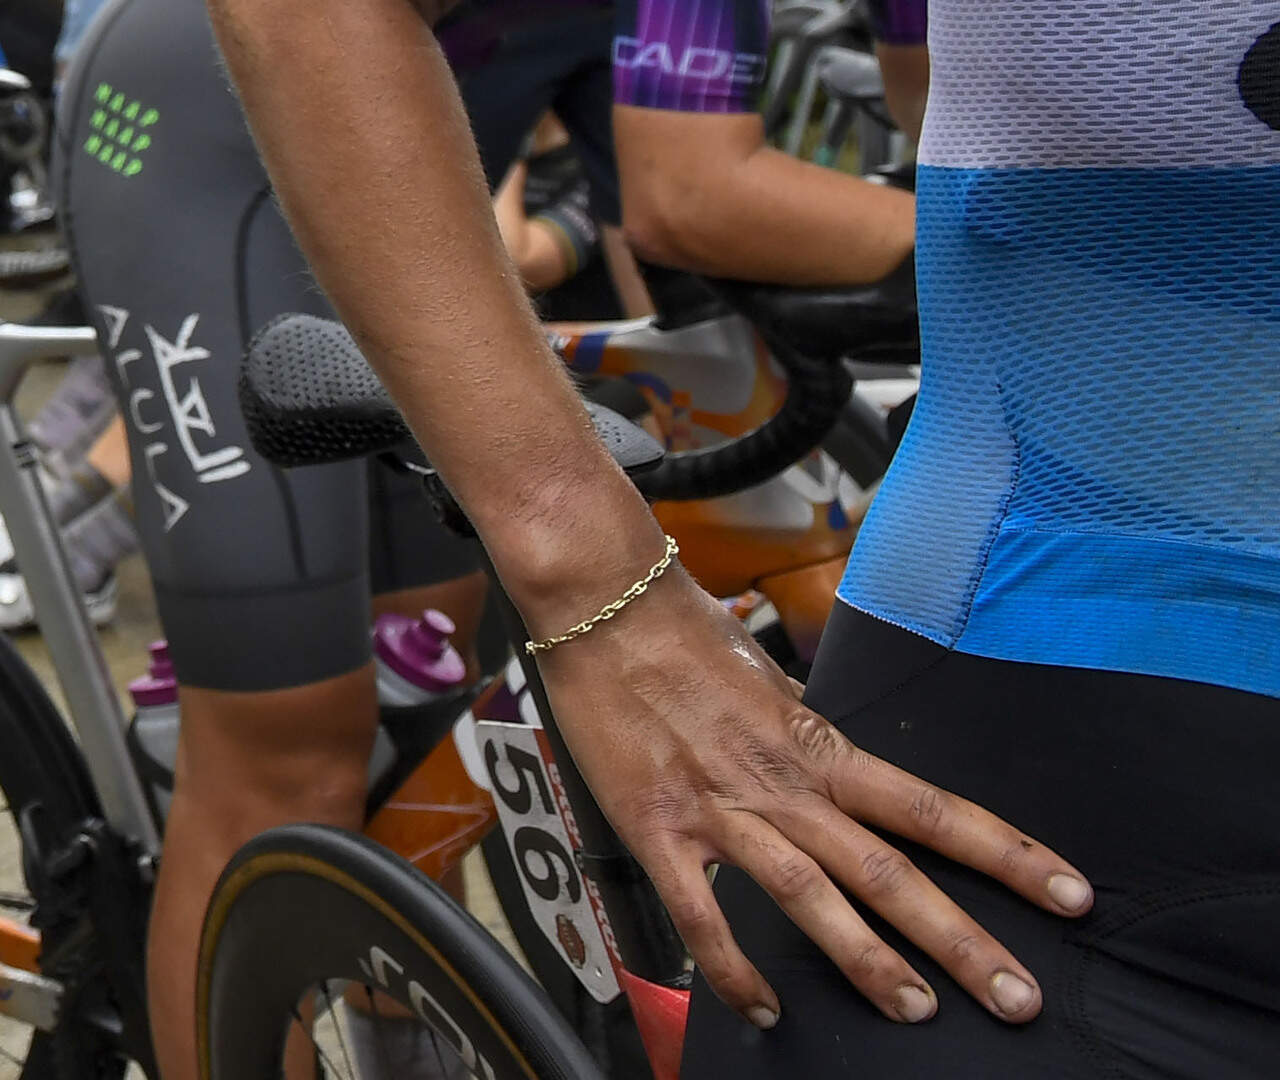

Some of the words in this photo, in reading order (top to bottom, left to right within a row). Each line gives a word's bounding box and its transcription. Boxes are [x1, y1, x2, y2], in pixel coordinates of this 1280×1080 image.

[611, 34, 767, 84] CADE
[95, 303, 190, 534] ALULA
[483, 736, 583, 905] 56
